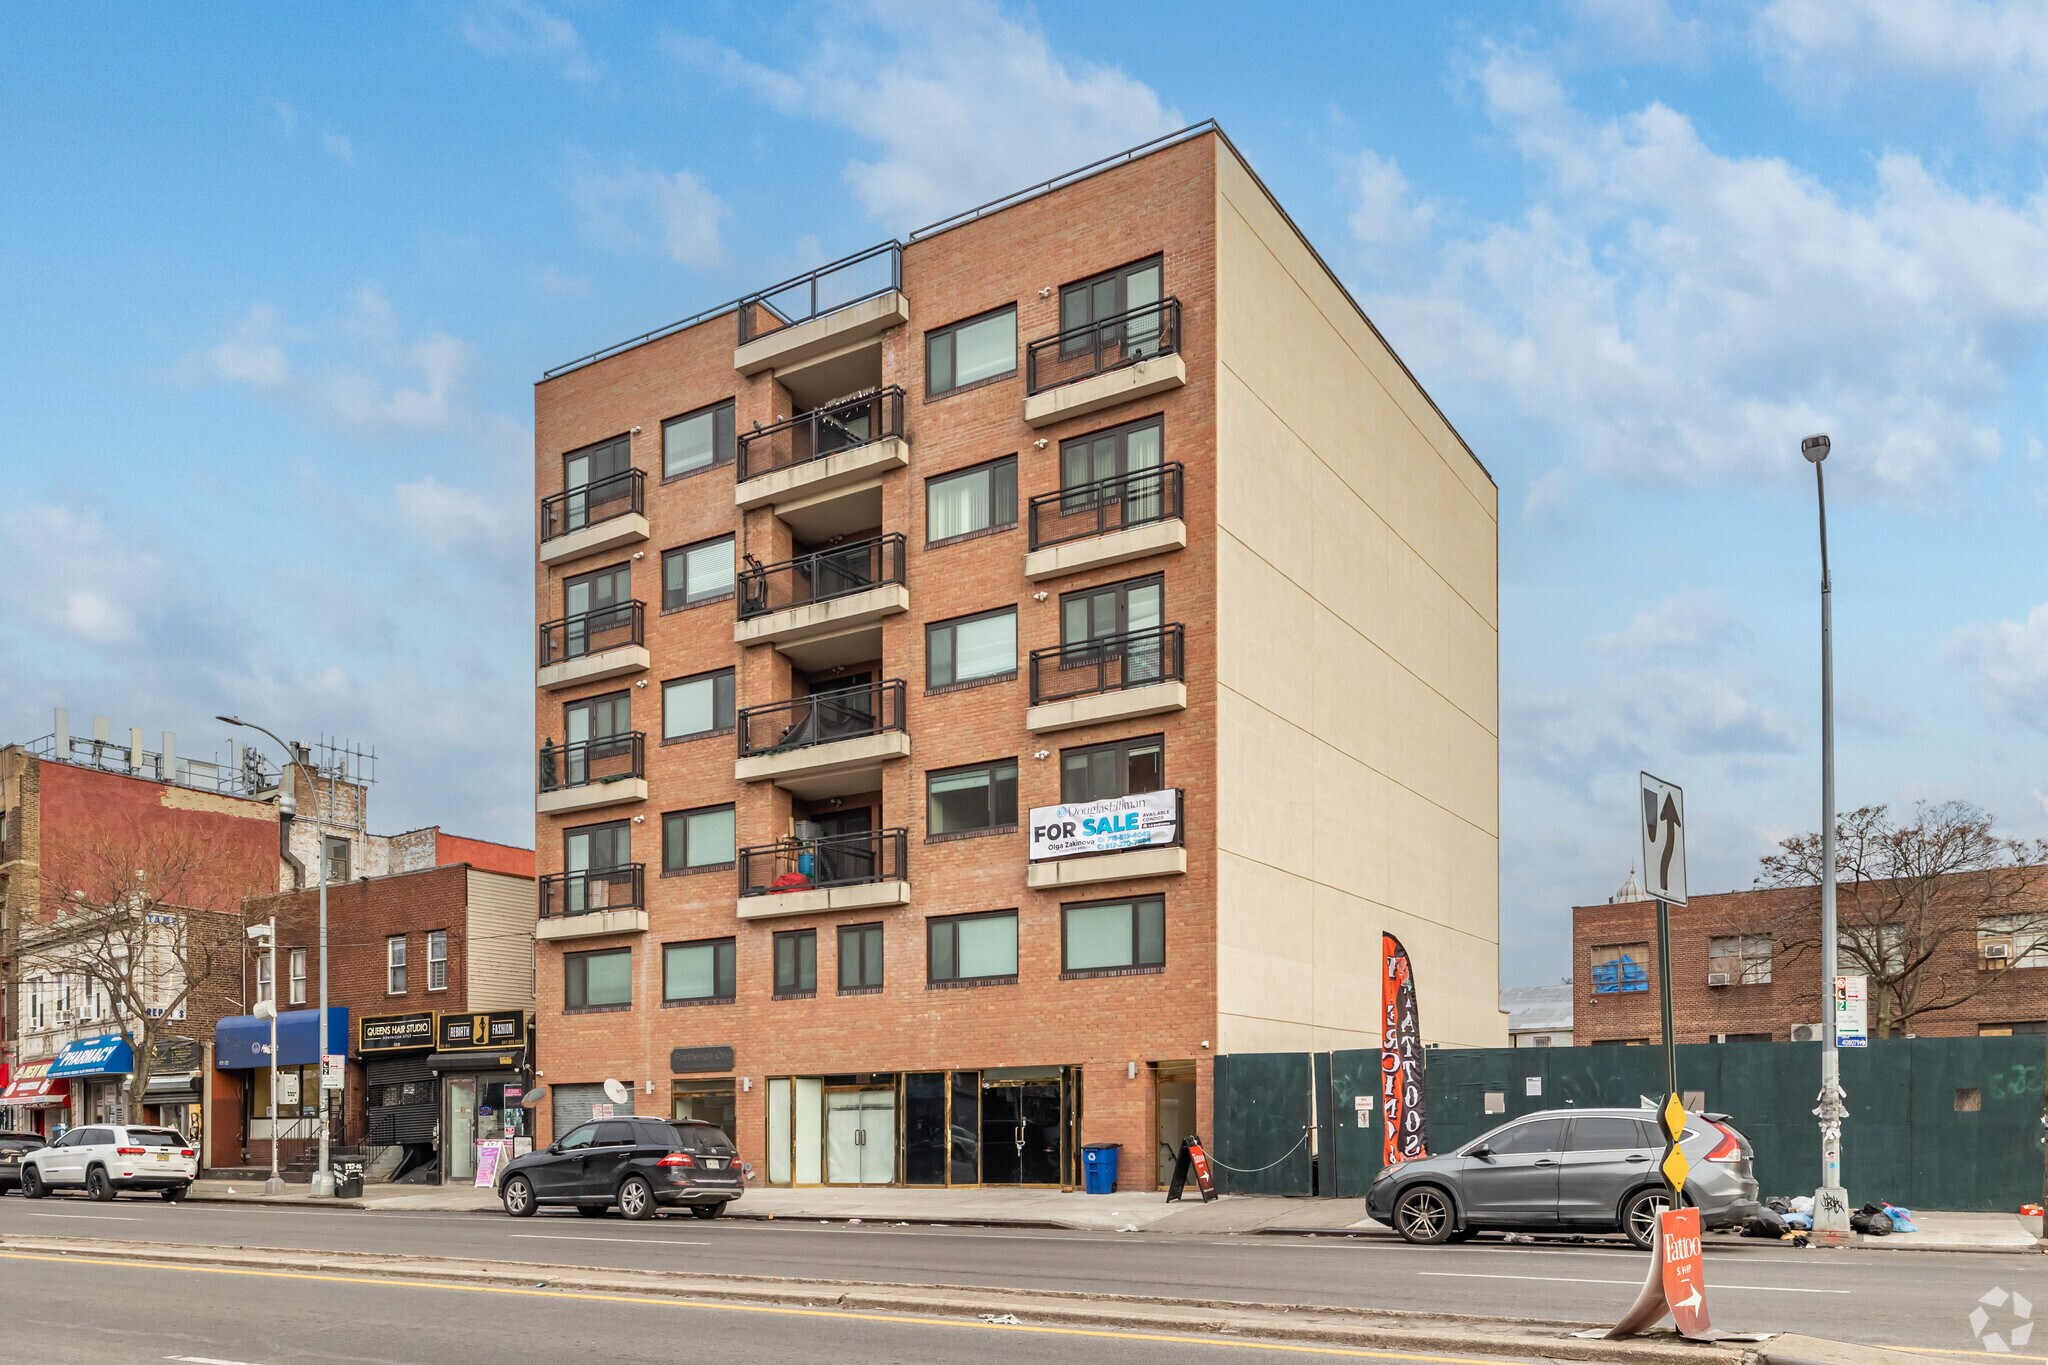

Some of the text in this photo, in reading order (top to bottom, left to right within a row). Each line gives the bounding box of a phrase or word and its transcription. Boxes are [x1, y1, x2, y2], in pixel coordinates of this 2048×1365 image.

[1142, 810, 1170, 818] AVAILABLE
[1142, 815, 1164, 823] CONDOS
[1034, 812, 1139, 843] FOR SALE
[1048, 839, 1095, 851] Olga Zakinova
[367, 1023, 428, 1036] QUEENS HAIR STUDIO
[450, 1023, 513, 1038] REBIRTH FASHION
[59, 1046, 117, 1067] PHARMACY
[1664, 1233, 1701, 1263] Tattoo
